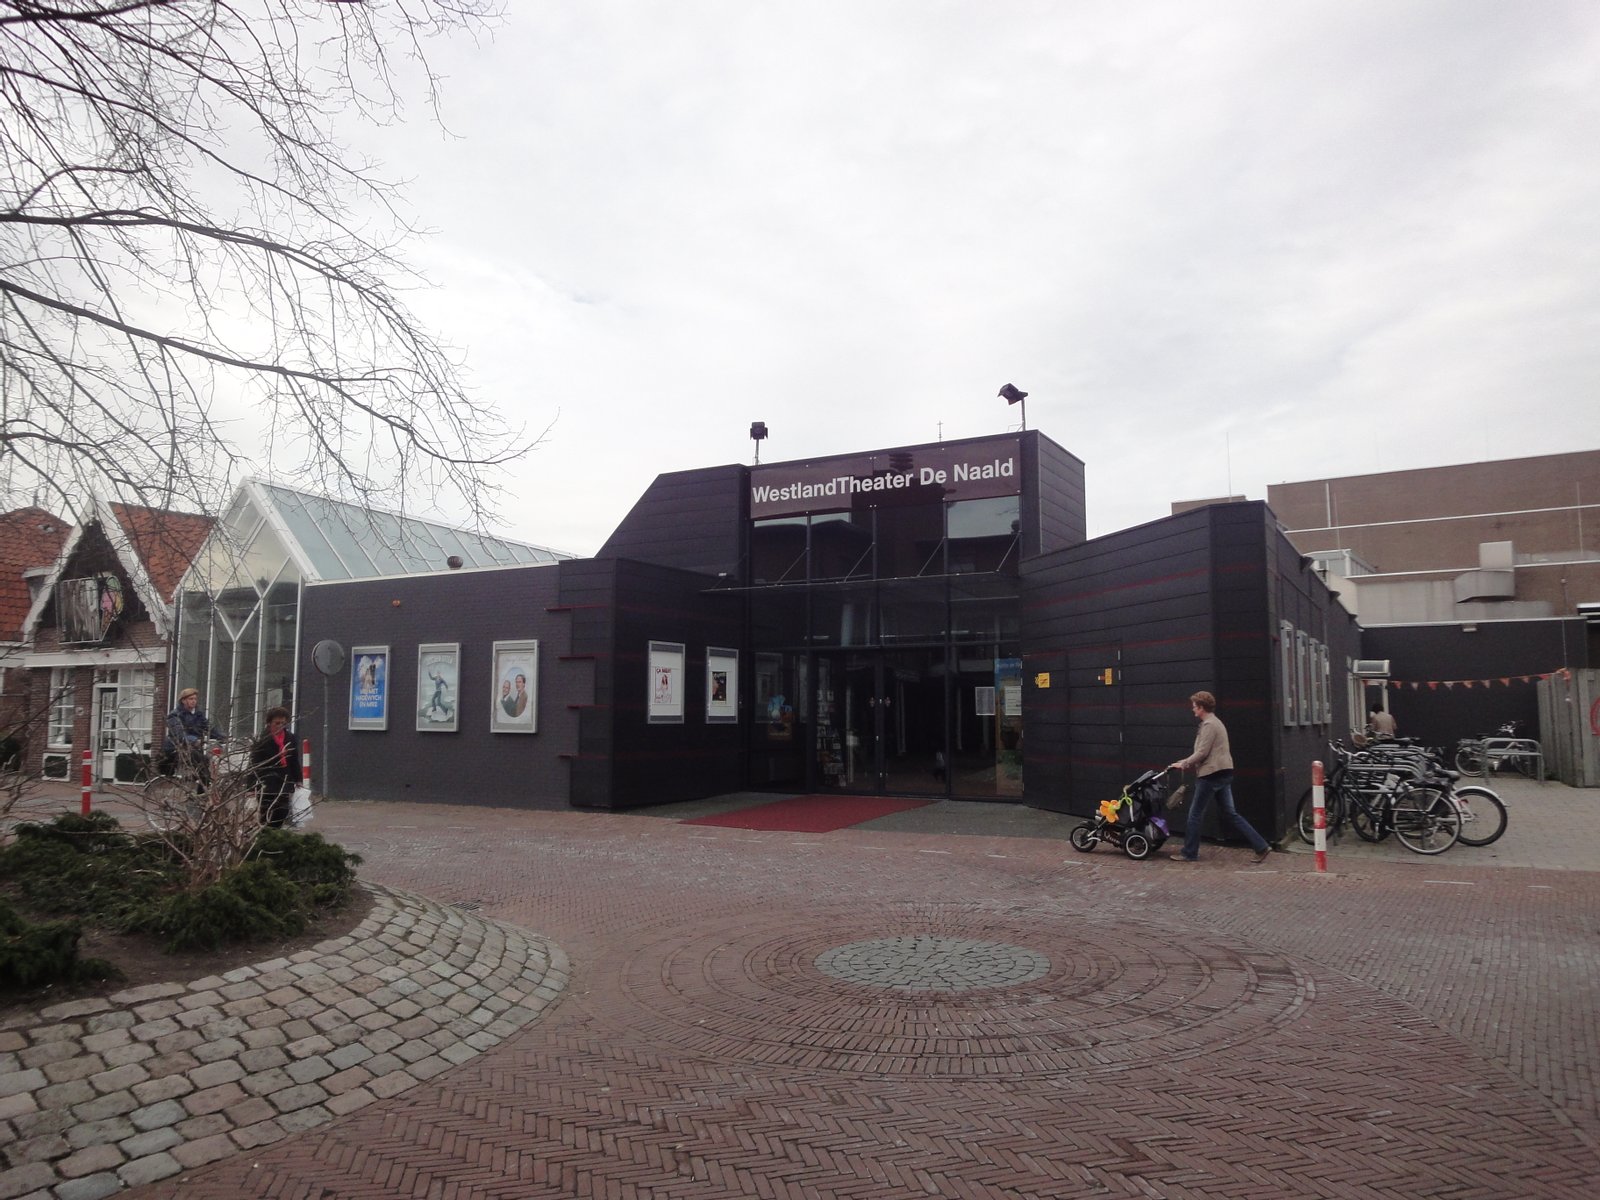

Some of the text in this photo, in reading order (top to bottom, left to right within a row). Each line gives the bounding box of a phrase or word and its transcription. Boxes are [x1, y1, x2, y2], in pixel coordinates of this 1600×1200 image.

[752, 457, 1014, 503] WestlandTheater De Naald
